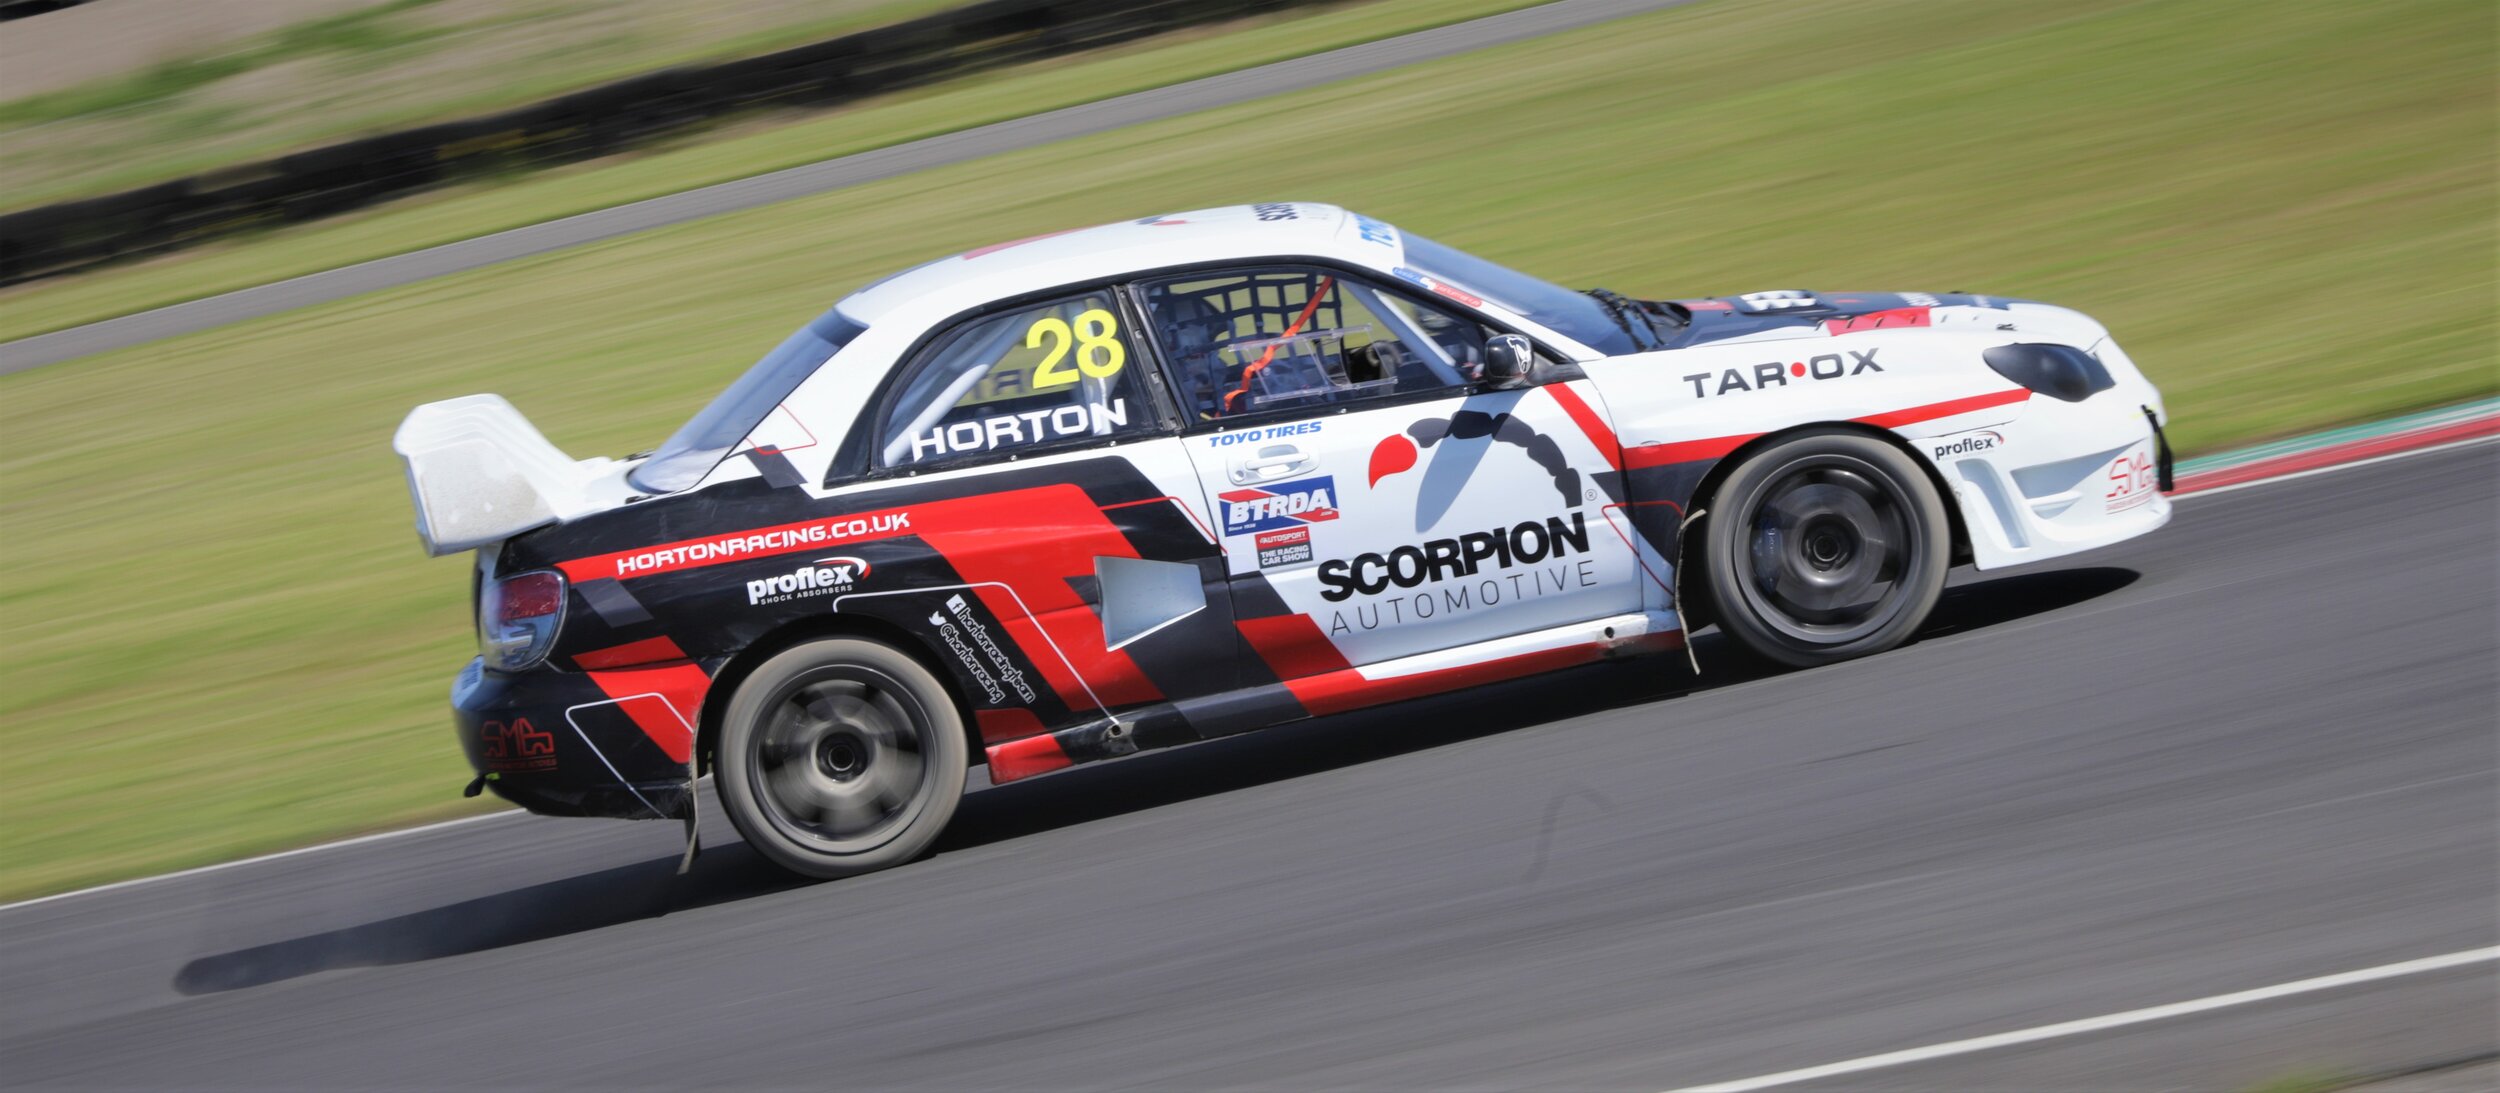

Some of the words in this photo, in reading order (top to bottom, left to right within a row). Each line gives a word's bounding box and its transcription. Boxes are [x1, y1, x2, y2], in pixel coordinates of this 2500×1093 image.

[1026, 309, 1125, 389] 28
[910, 398, 1128, 462] HORTON
[1209, 430, 1262, 447] TOYO
[1265, 421, 1322, 438] TIRES
[1934, 437, 1994, 461] proflex
[1228, 487, 1332, 525] BTRDA
[616, 512, 911, 575] HORTONRACING.CO.UK
[1260, 549, 1277, 559] THE
[1277, 545, 1310, 556] RACING
[1261, 556, 1282, 566] CAR
[1281, 551, 1310, 563] SHOW
[1317, 511, 1590, 602] SCORPION
[746, 565, 854, 605] proflex
[760, 594, 793, 605] SHOCK
[796, 584, 853, 599] ABSORBERS
[1330, 559, 1598, 637] AUTOMOTIVE
[939, 622, 1006, 704] @hortonracing
